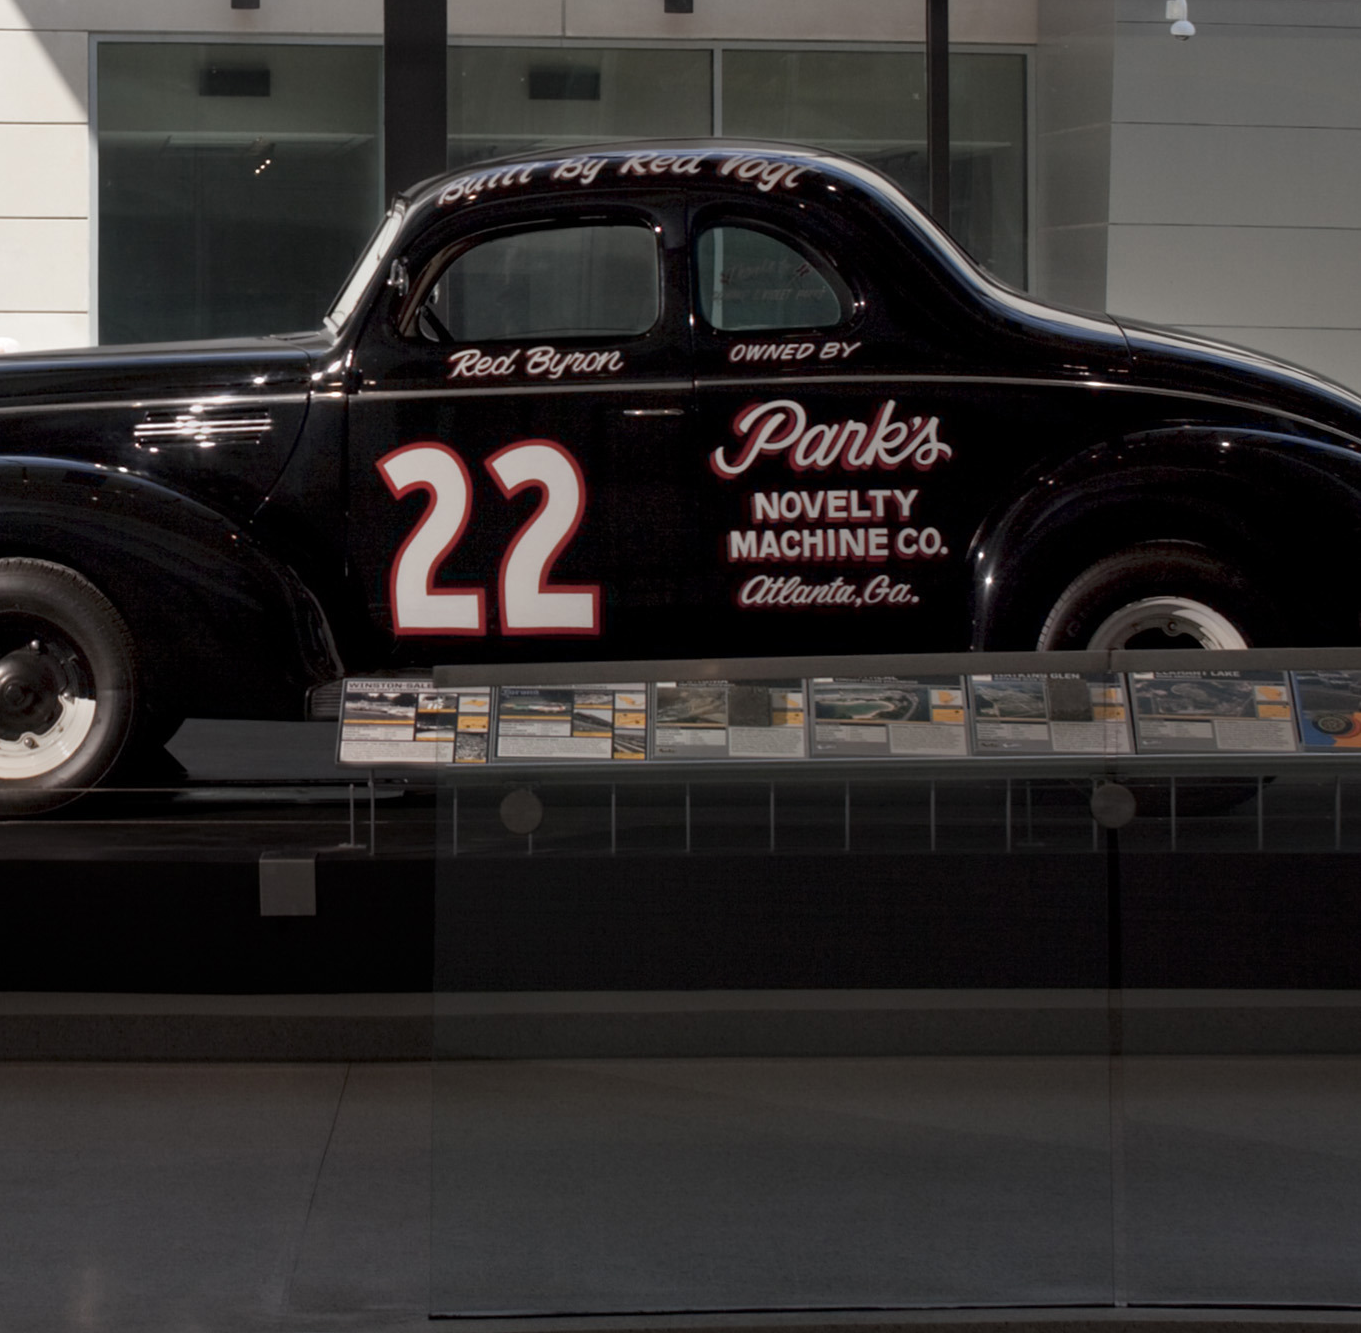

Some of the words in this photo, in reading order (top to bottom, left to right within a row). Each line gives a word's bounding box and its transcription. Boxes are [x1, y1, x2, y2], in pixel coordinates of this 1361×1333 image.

[438, 162, 536, 205] Built
[552, 156, 610, 185] By
[619, 152, 708, 177] Red
[718, 154, 819, 192] Vogt
[449, 347, 518, 379] Red
[525, 345, 624, 380] Byron
[730, 344, 815, 362] OWNED
[819, 341, 862, 359] BY
[714, 399, 952, 475] Park's
[752, 488, 919, 521] NOVELTY
[376, 439, 601, 636] 22
[729, 527, 890, 560] MACHINE
[896, 526, 950, 558] CO.
